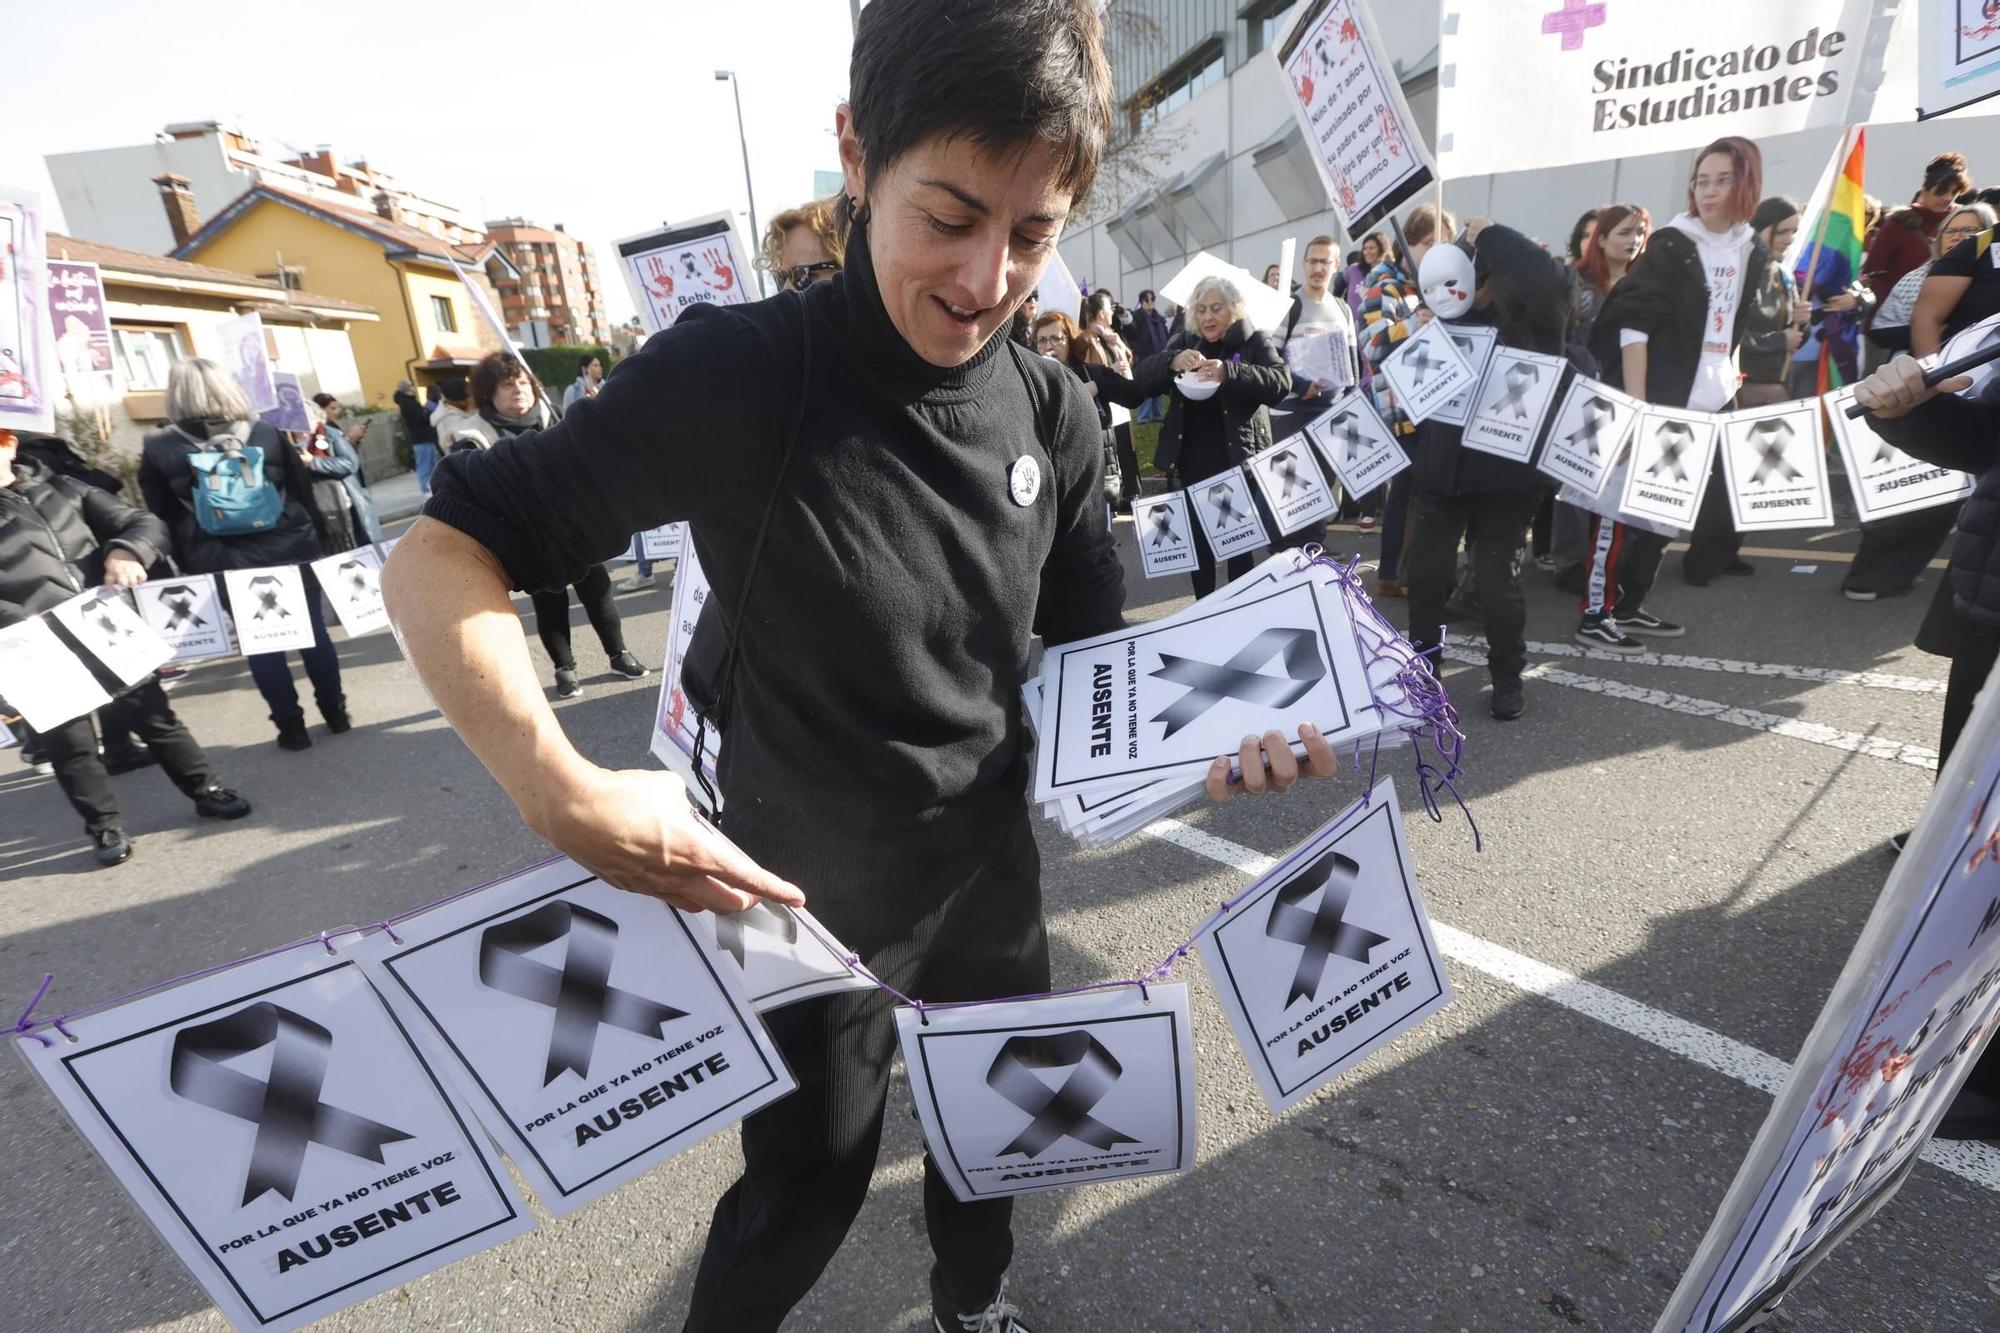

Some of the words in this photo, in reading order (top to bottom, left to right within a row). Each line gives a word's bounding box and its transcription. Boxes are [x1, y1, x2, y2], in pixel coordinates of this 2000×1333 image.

[1592, 45, 1780, 94] Sindicato
[1786, 27, 1846, 66] de
[1328, 93, 1337, 107] de
[1336, 82, 1343, 95] 7
[1345, 61, 1365, 87] años
[1321, 102, 1357, 143] asesinado
[1358, 84, 1371, 106] por
[1592, 70, 1839, 132] Estudiantes
[1327, 151, 1336, 165] su
[1337, 130, 1357, 157] padre
[1358, 113, 1373, 133] que
[1374, 103, 1384, 117] lo
[1357, 144, 1370, 164] por
[1371, 135, 1382, 149] un
[1354, 158, 1389, 192] barranco
[1419, 371, 1459, 403] AUSENTE
[1479, 425, 1523, 442] AUSENTE
[1355, 452, 1392, 480] AUSENTE
[1555, 453, 1595, 479] AUSENTE
[1877, 467, 1950, 493] AUSENTE
[1287, 496, 1322, 518] AUSENTE
[1638, 490, 1685, 507] AUSENTE
[1751, 497, 1811, 509] AUSENTE
[1221, 530, 1255, 546] AUSENTE
[1154, 552, 1187, 564] AUSENTE
[254, 630, 299, 640] AUSENTE
[1127, 641, 1135, 657] POR
[1127, 657, 1136, 668] LA
[1127, 669, 1136, 686] QUE
[1128, 686, 1137, 699] YA
[1128, 699, 1137, 712] NO
[1090, 663, 1112, 758] AUSENTE
[1128, 713, 1137, 739] TIENE
[1128, 740, 1138, 760] VOZ
[1266, 1031, 1288, 1048] POR
[1290, 1021, 1303, 1032] LA
[1304, 1005, 1326, 1022] QUE
[1327, 995, 1342, 1007] YA
[1343, 984, 1358, 997] NO
[1359, 962, 1389, 985] TIENE
[1390, 947, 1412, 964] VOZ
[1297, 971, 1412, 1058] AUSENTE
[525, 1113, 556, 1132] POR
[557, 1102, 577, 1116] LA
[578, 1084, 608, 1104] QUE
[609, 1074, 631, 1087] YA
[631, 1062, 652, 1077] NO
[653, 1040, 695, 1064] TIENE
[695, 1025, 724, 1044] VOZ
[575, 1051, 730, 1147] AUSENTE
[1092, 1152, 1131, 1161] TIENE
[1000, 1158, 1150, 1182] AUSENTE
[1804, 1119, 1921, 1234] golpes
[219, 1234, 256, 1254] POR
[257, 1224, 281, 1238] LA
[282, 1208, 318, 1228] QUE
[319, 1198, 344, 1213] YA
[345, 1187, 370, 1202] NO
[371, 1166, 421, 1191] TIENE
[421, 1151, 456, 1171] VOZ
[278, 1181, 462, 1274] AUSENTE
